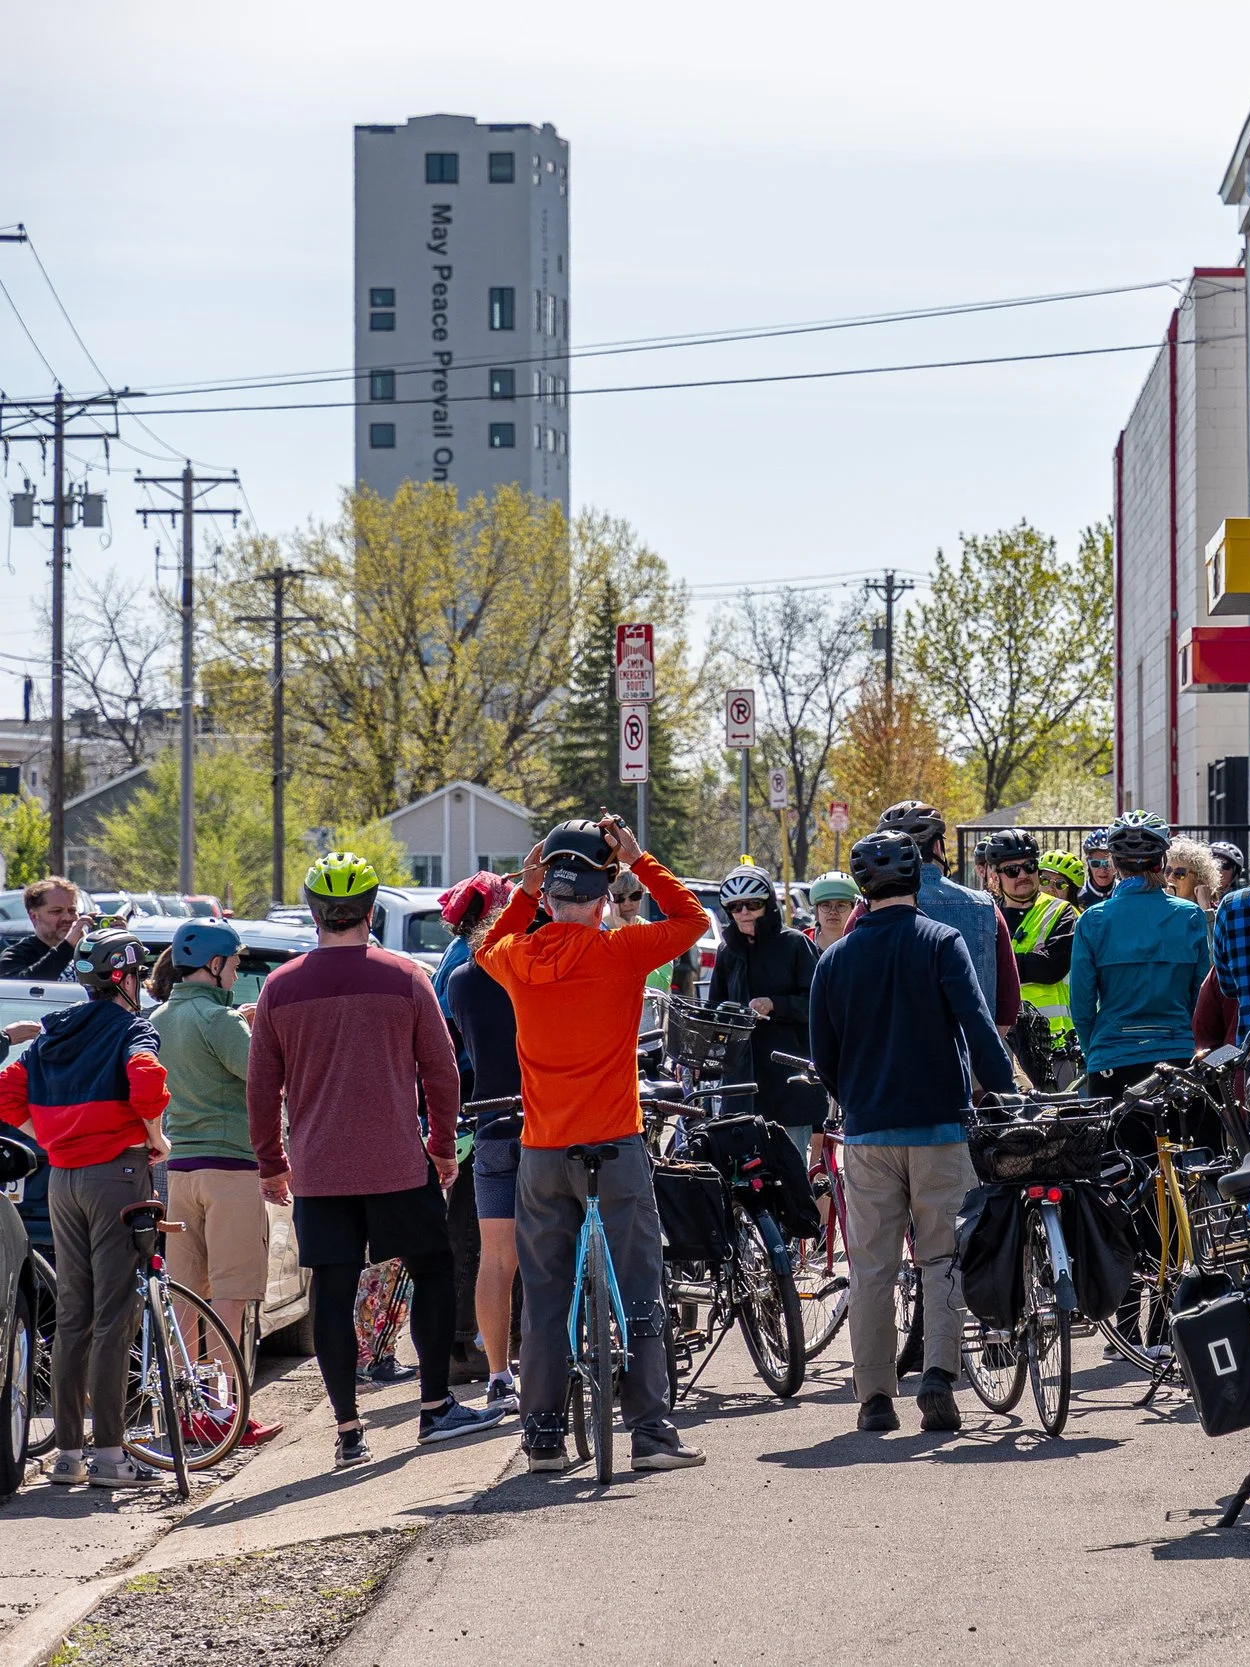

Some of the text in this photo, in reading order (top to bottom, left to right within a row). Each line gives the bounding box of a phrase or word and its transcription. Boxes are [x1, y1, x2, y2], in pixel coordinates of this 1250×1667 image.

[426, 204, 453, 482] May Peace Prevail On
[627, 659, 644, 669] SNOW
[620, 670, 651, 680] EMERGENCY
[626, 681, 645, 691] ROUTE
